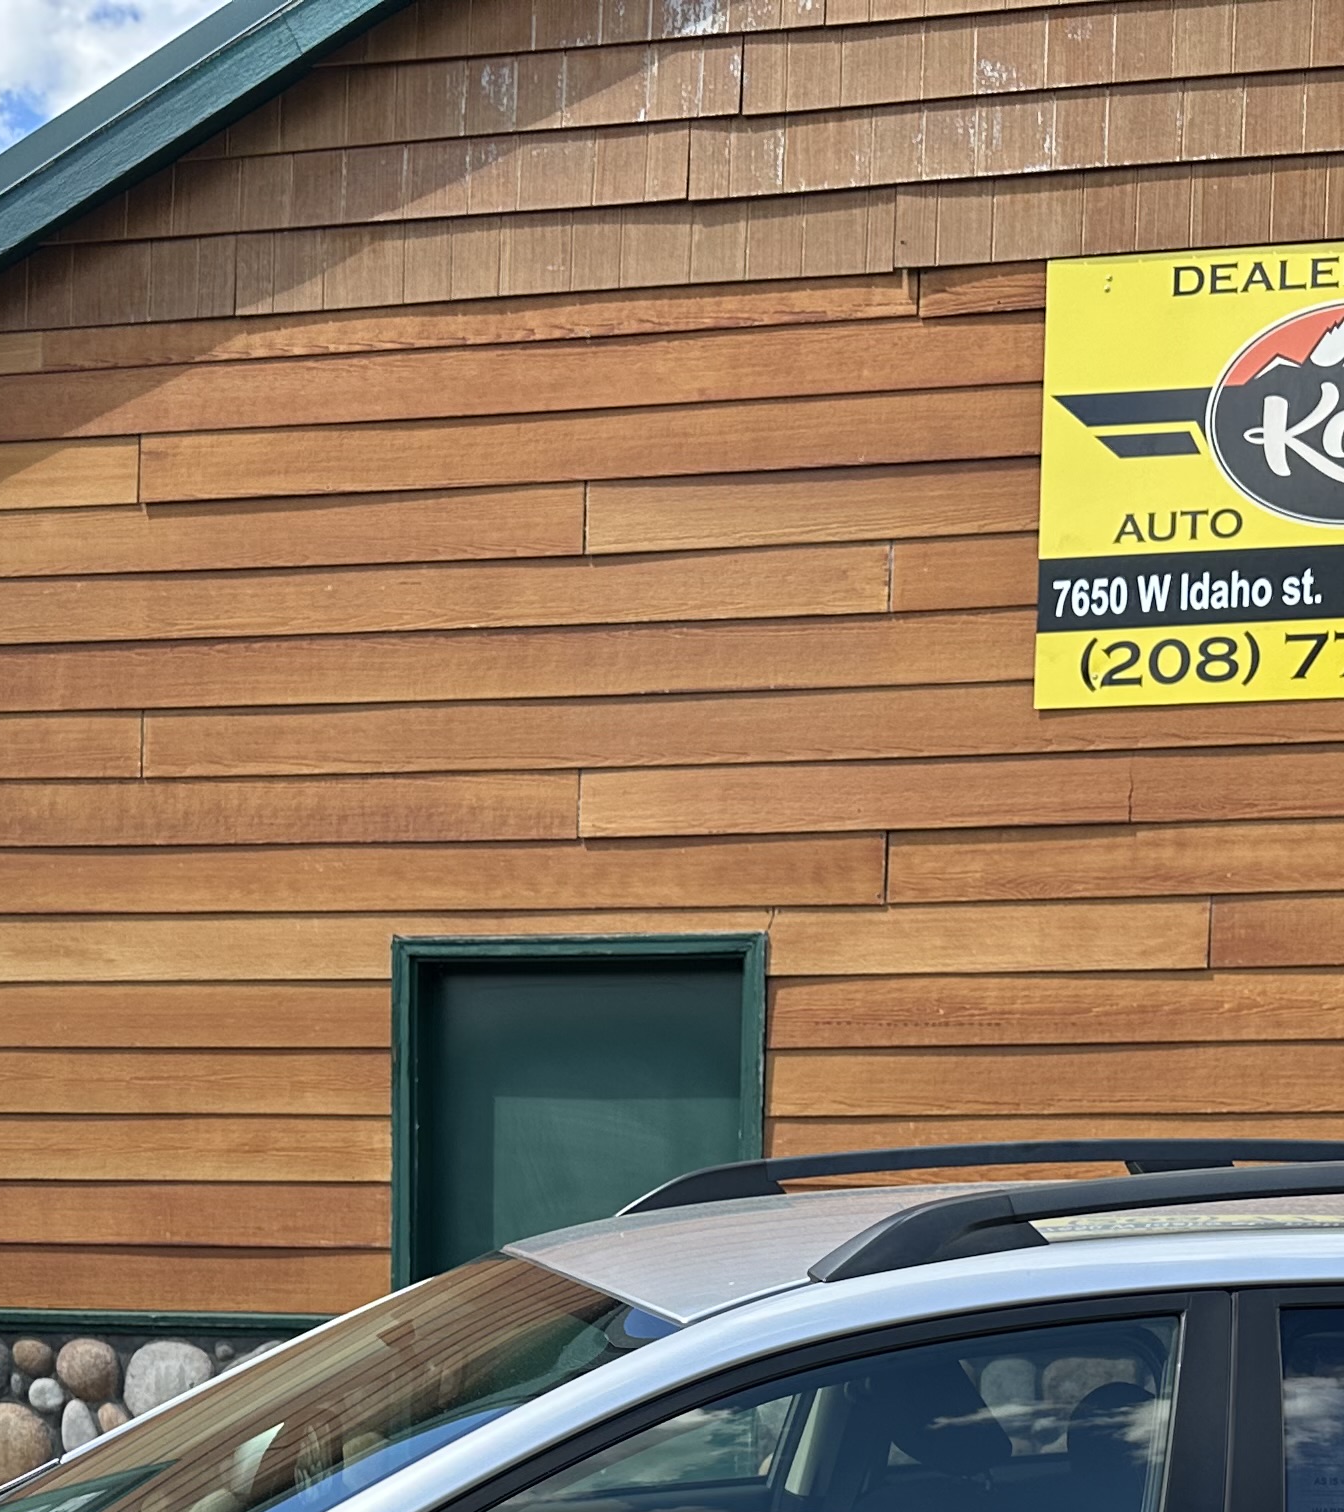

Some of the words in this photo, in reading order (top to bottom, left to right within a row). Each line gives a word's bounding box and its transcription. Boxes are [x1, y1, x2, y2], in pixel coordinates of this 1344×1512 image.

[1113, 508, 1243, 545] AUTO
[1052, 579, 1130, 618] 7650
[1138, 574, 1173, 613] W
[1180, 571, 1273, 612] Idaho
[1281, 569, 1323, 606] st.
[1079, 631, 1261, 693] (208)
